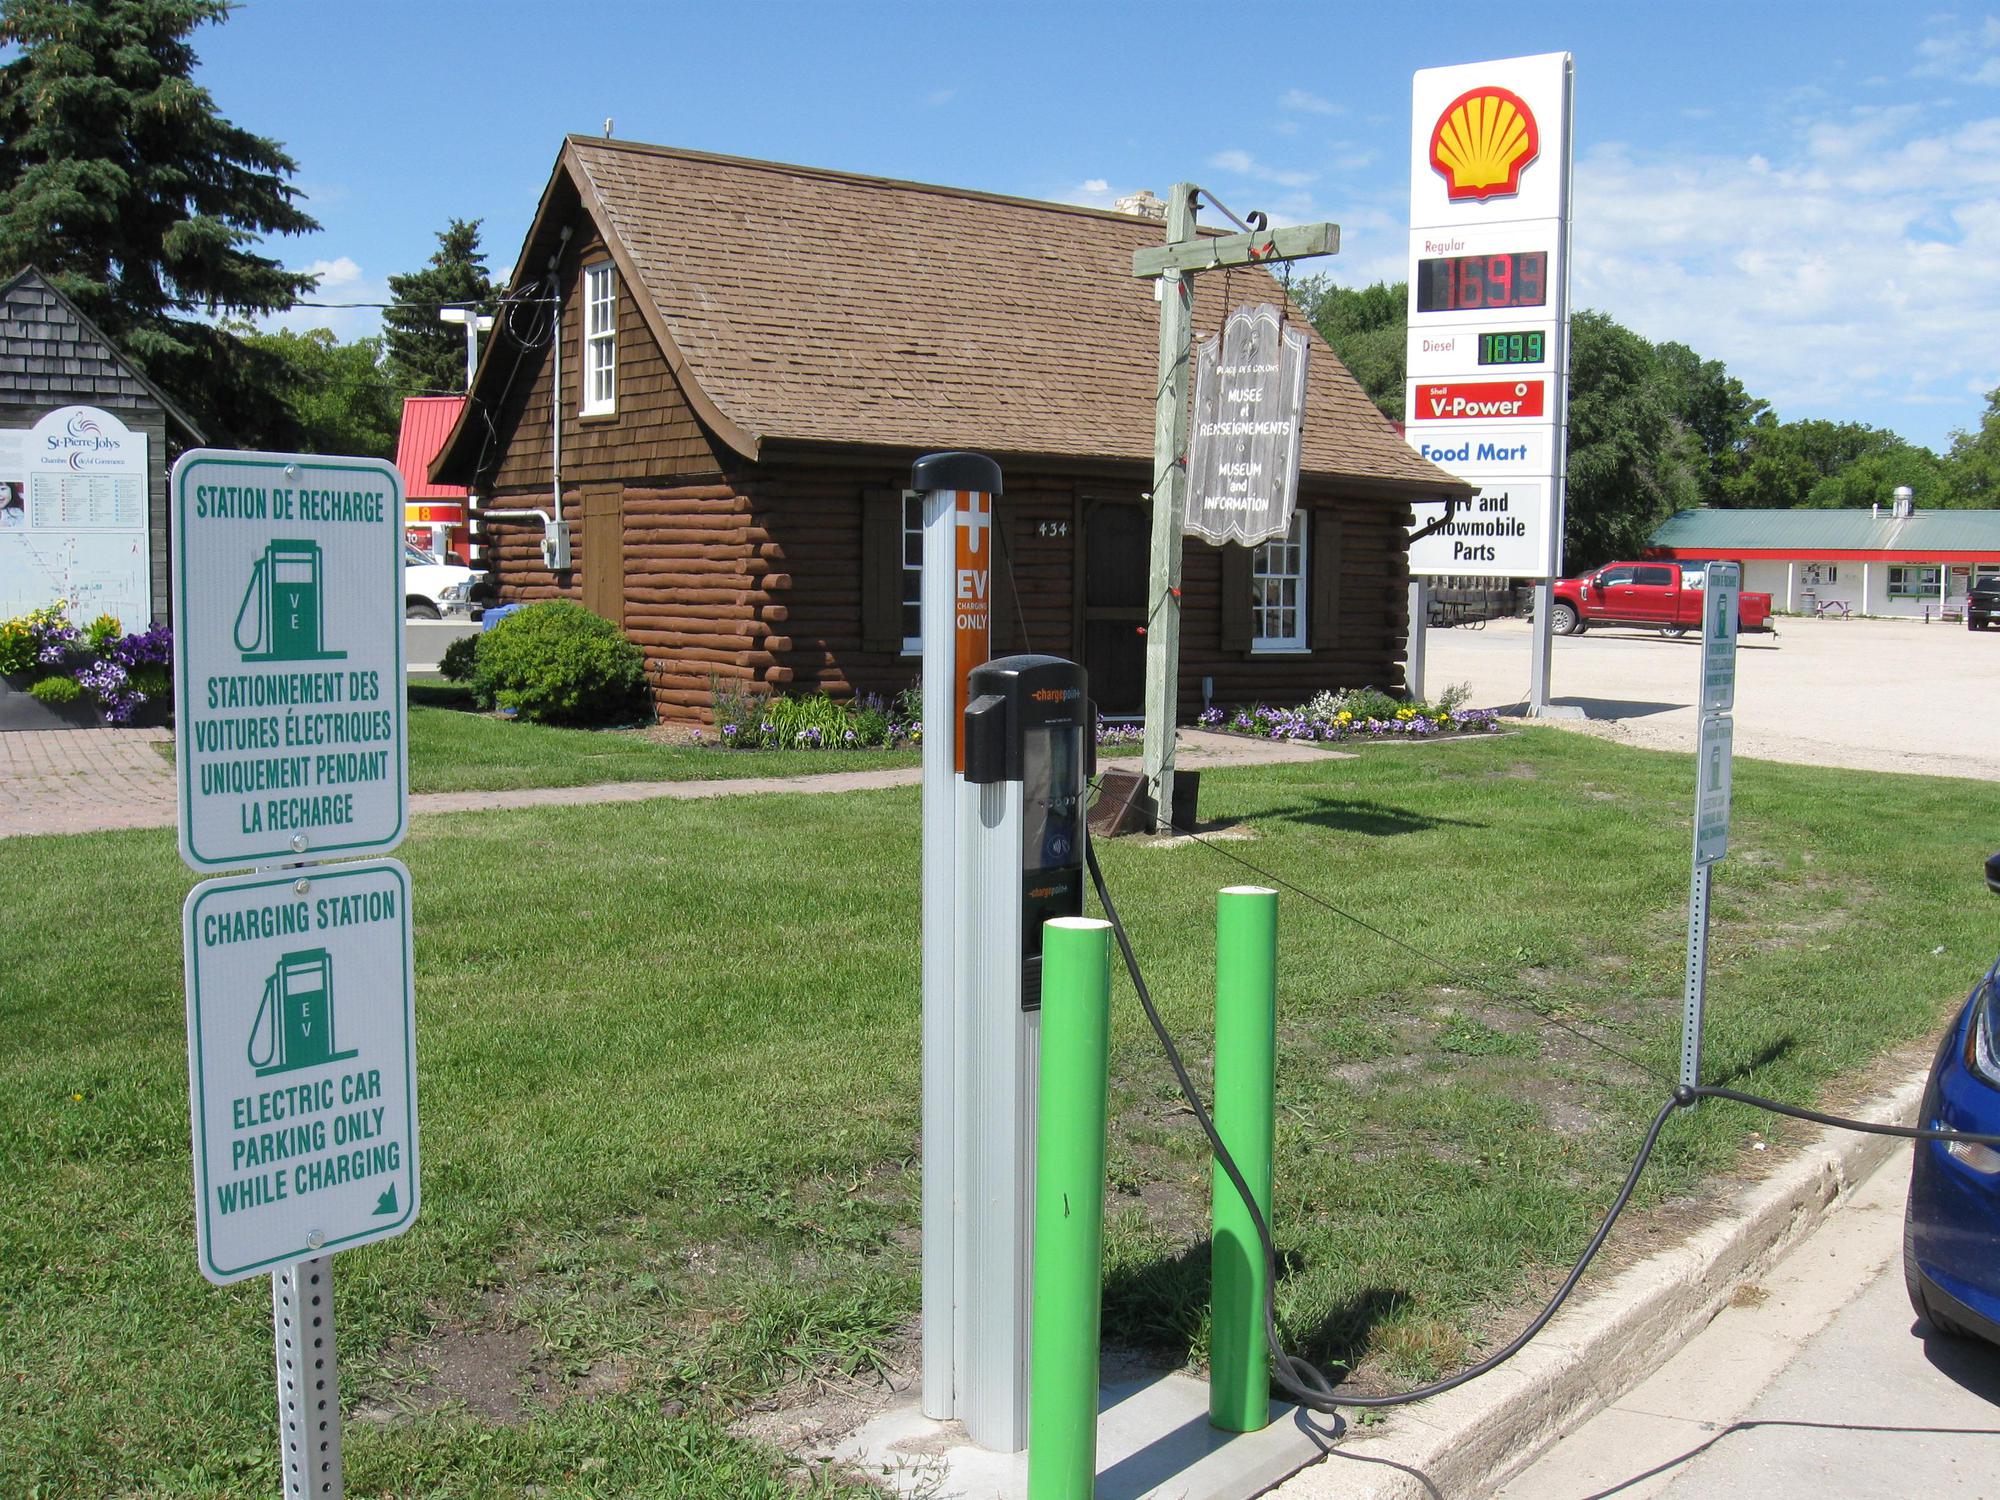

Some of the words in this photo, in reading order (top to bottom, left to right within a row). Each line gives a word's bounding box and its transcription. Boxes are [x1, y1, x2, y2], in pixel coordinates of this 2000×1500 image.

[1425, 240, 1465, 255] Regular
[1422, 338, 1455, 352] Diesel
[1485, 333, 1543, 364] 189.9
[1238, 364, 1252, 374] DES
[1430, 387, 1448, 396] Shell
[1430, 396, 1523, 417] V-Power
[47, 435, 121, 452] St-Pierre-Jolys
[1421, 441, 1470, 462] Food
[1476, 443, 1527, 462] Mart
[1218, 463, 1262, 476] MUSEUM
[1229, 479, 1248, 492] and
[196, 484, 267, 520] STATION
[273, 488, 294, 521] DE
[299, 489, 384, 523] RECHARGE
[1203, 493, 1269, 512] INFORMATION
[1479, 492, 1509, 512] and
[421, 507, 431, 521] 8
[1038, 521, 1067, 537] 434
[1453, 541, 1495, 561] Parts
[957, 569, 987, 599] EV
[957, 602, 987, 610] CHARGING
[956, 614, 987, 630] ONLY
[207, 672, 344, 710] STATIONNEMENT
[349, 670, 379, 702] DES
[195, 717, 279, 753] VOITURES
[285, 708, 391, 747] ÉLECTRIQUES
[201, 756, 310, 796] UNIQUEMENT
[316, 750, 388, 785] PENDANT
[241, 801, 263, 834] LA
[268, 794, 353, 831] RECHARGE
[204, 903, 309, 947] CHARGING
[317, 890, 395, 930] STATION
[233, 1079, 334, 1130] ELECTRIC
[341, 1069, 381, 1104] CAR
[232, 1121, 326, 1171] PARKING
[334, 1106, 385, 1147] ONLY
[217, 1170, 287, 1216] WHILE
[295, 1141, 401, 1195] CHARGING
